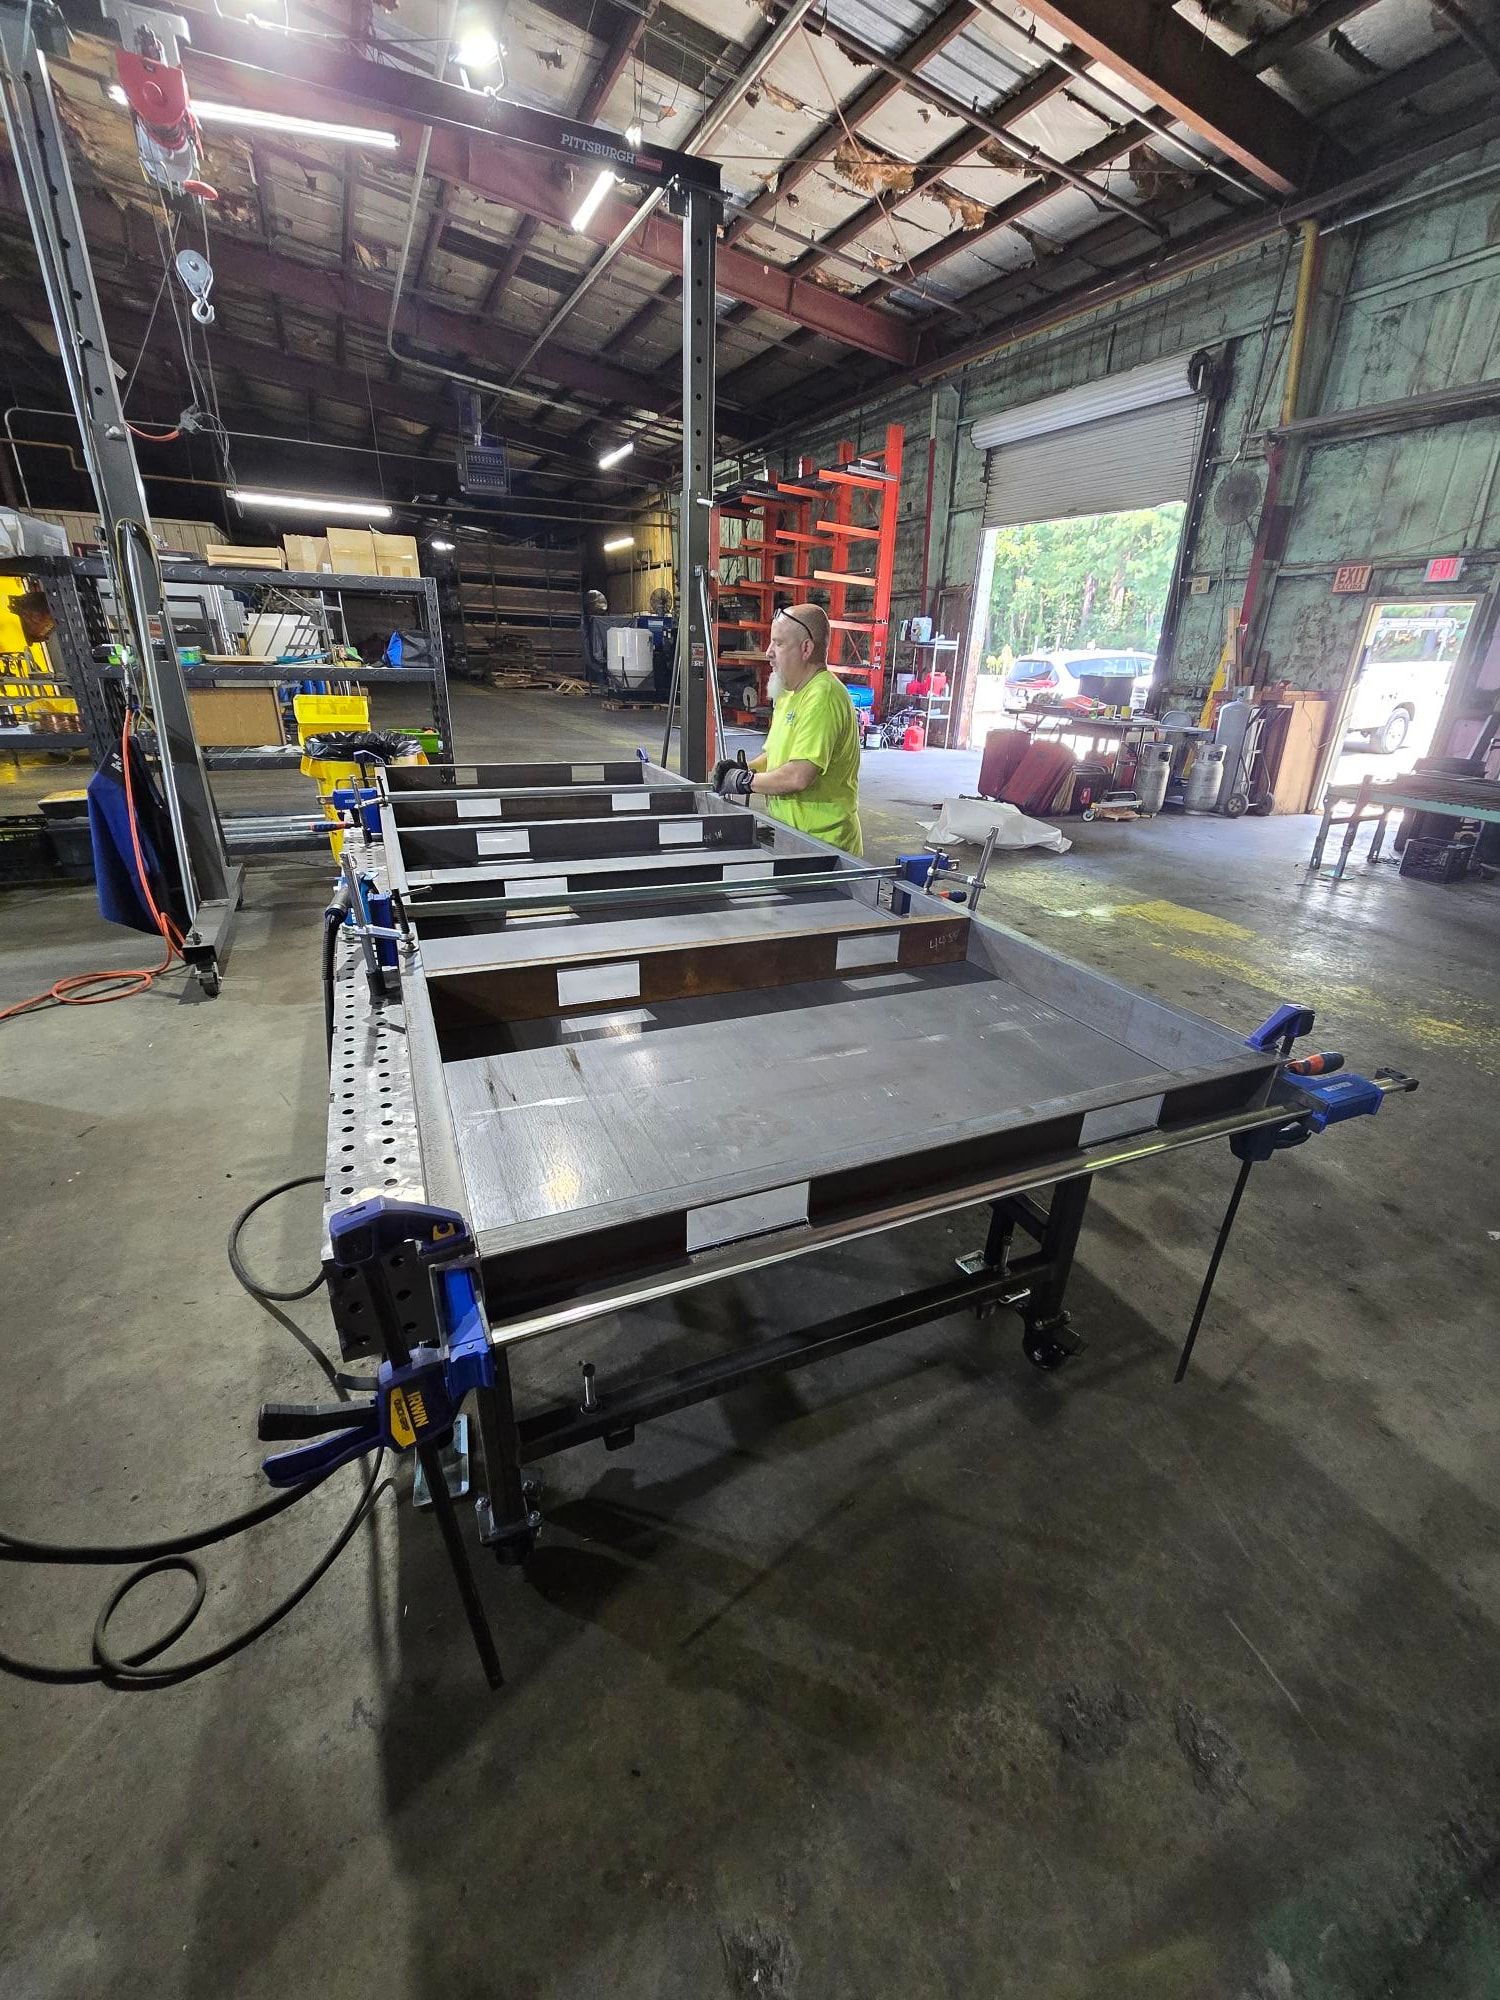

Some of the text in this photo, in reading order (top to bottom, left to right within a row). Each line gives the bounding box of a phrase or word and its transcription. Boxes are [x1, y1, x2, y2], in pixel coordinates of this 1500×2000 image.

[561, 133, 636, 165] PITTSBURGH
[1337, 567, 1369, 584] EXIT
[1429, 559, 1459, 580] EXIT
[407, 1391, 429, 1428] IRWIN
